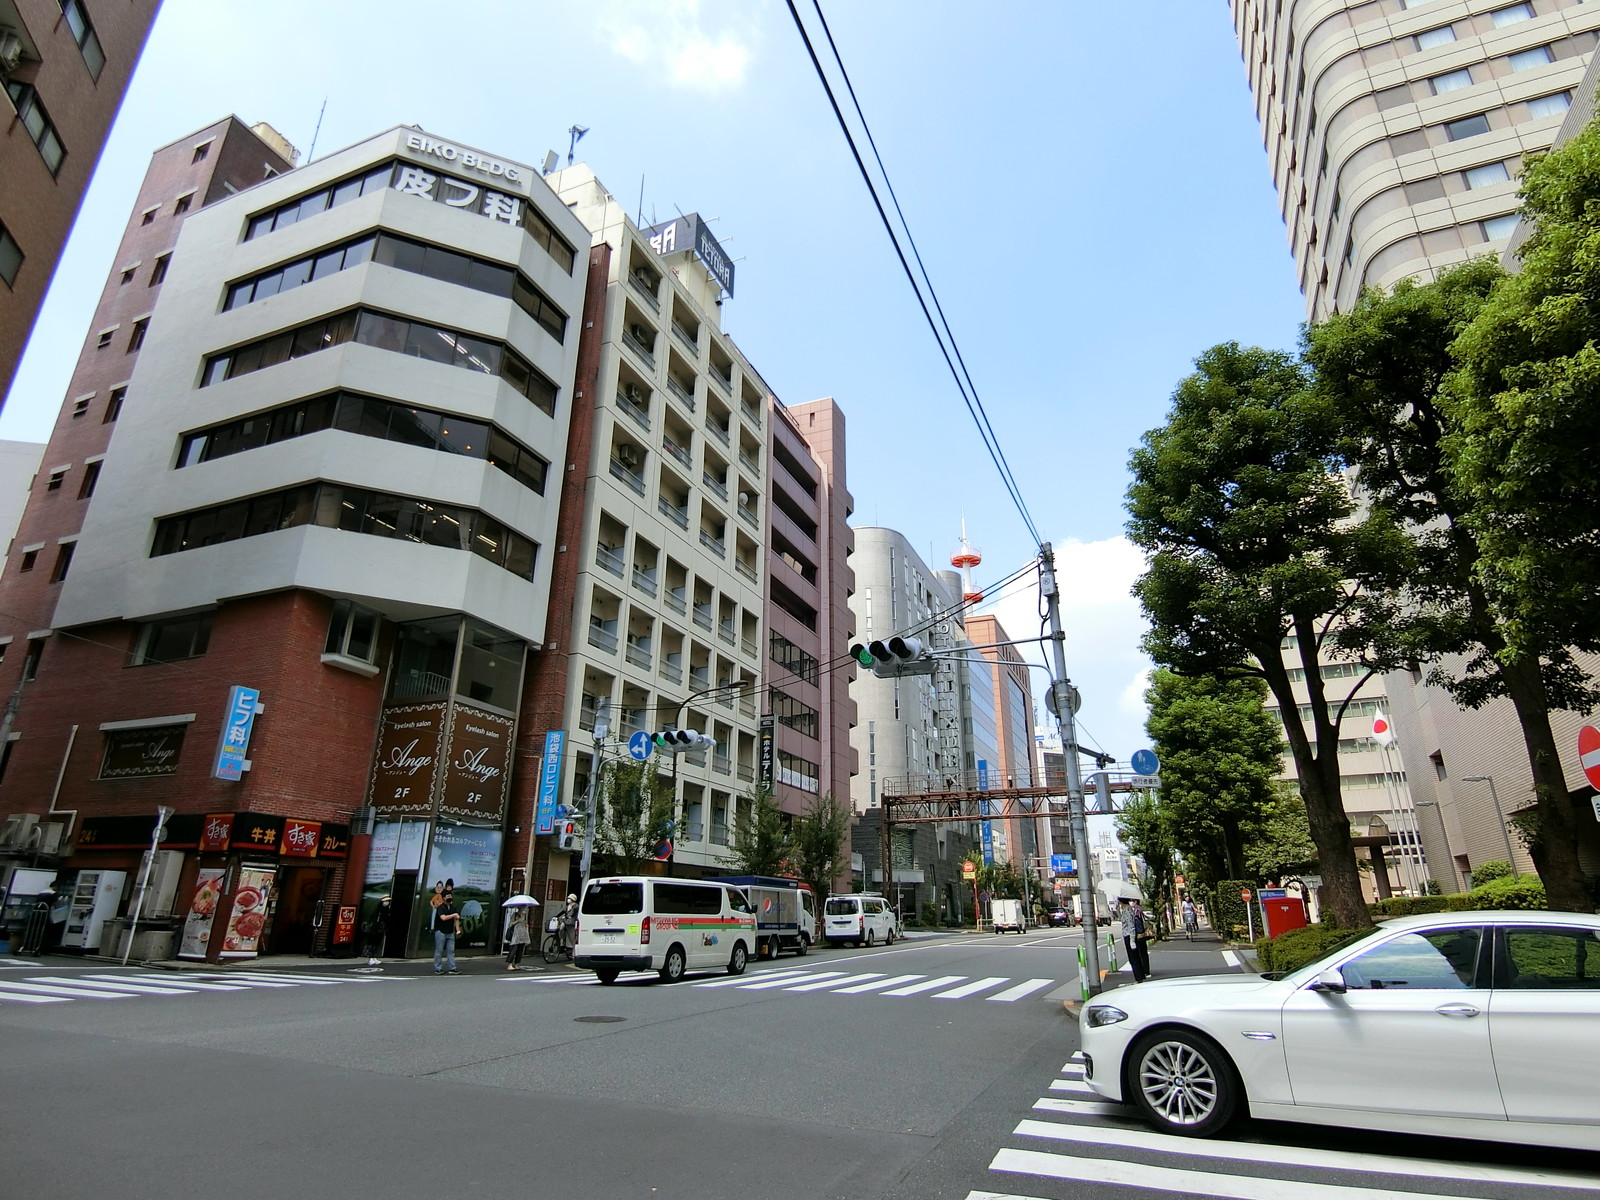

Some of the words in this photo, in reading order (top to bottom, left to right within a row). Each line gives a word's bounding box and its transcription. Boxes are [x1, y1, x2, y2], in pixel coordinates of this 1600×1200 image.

[406, 134, 459, 161] EIKO
[462, 151, 523, 185] BLDG.
[395, 166, 521, 226] 皮フ科
[701, 237, 730, 288] TETORA
[229, 691, 253, 745] ヒフ科
[394, 721, 415, 730] Eyelash
[416, 720, 432, 728] salon
[465, 724, 486, 735] Eyelash
[485, 730, 500, 739] salon
[142, 736, 175, 764] Ange
[382, 738, 432, 776] Ange
[455, 747, 501, 783] Ange
[543, 733, 561, 806] 池袋西口ヒフ科
[761, 739, 771, 791] ホテルテトラ
[394, 787, 411, 799] 2F
[467, 792, 482, 804] 2F
[207, 817, 231, 843] すき家
[251, 827, 277, 844] 牛丼
[288, 823, 317, 848] すき家
[323, 835, 347, 850] カレー
